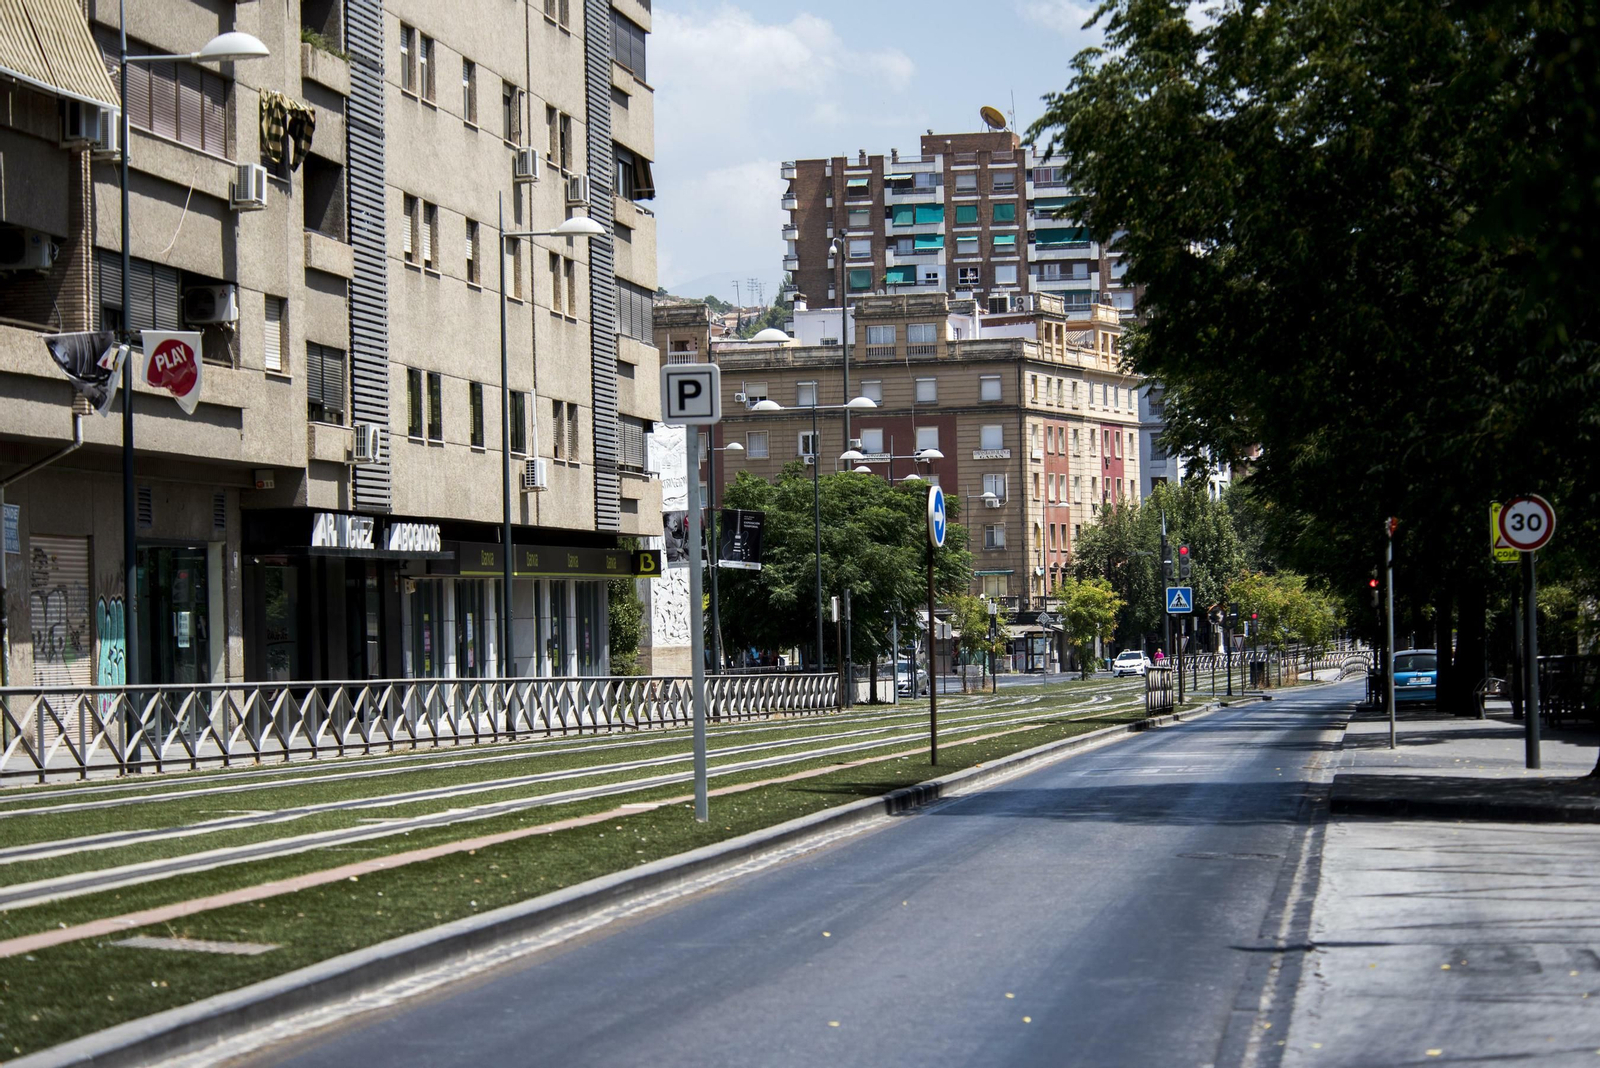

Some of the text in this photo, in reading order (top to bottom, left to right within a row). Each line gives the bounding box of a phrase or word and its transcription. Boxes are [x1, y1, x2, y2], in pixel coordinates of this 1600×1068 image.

[155, 344, 187, 372] PLAY
[678, 380, 702, 411] P
[4, 507, 18, 520] ENDE
[1511, 513, 1542, 531] 30
[390, 523, 440, 552] ABOGADOS
[481, 550, 617, 569] Bankia Bankia Bankia Bankia
[640, 553, 655, 571] B
